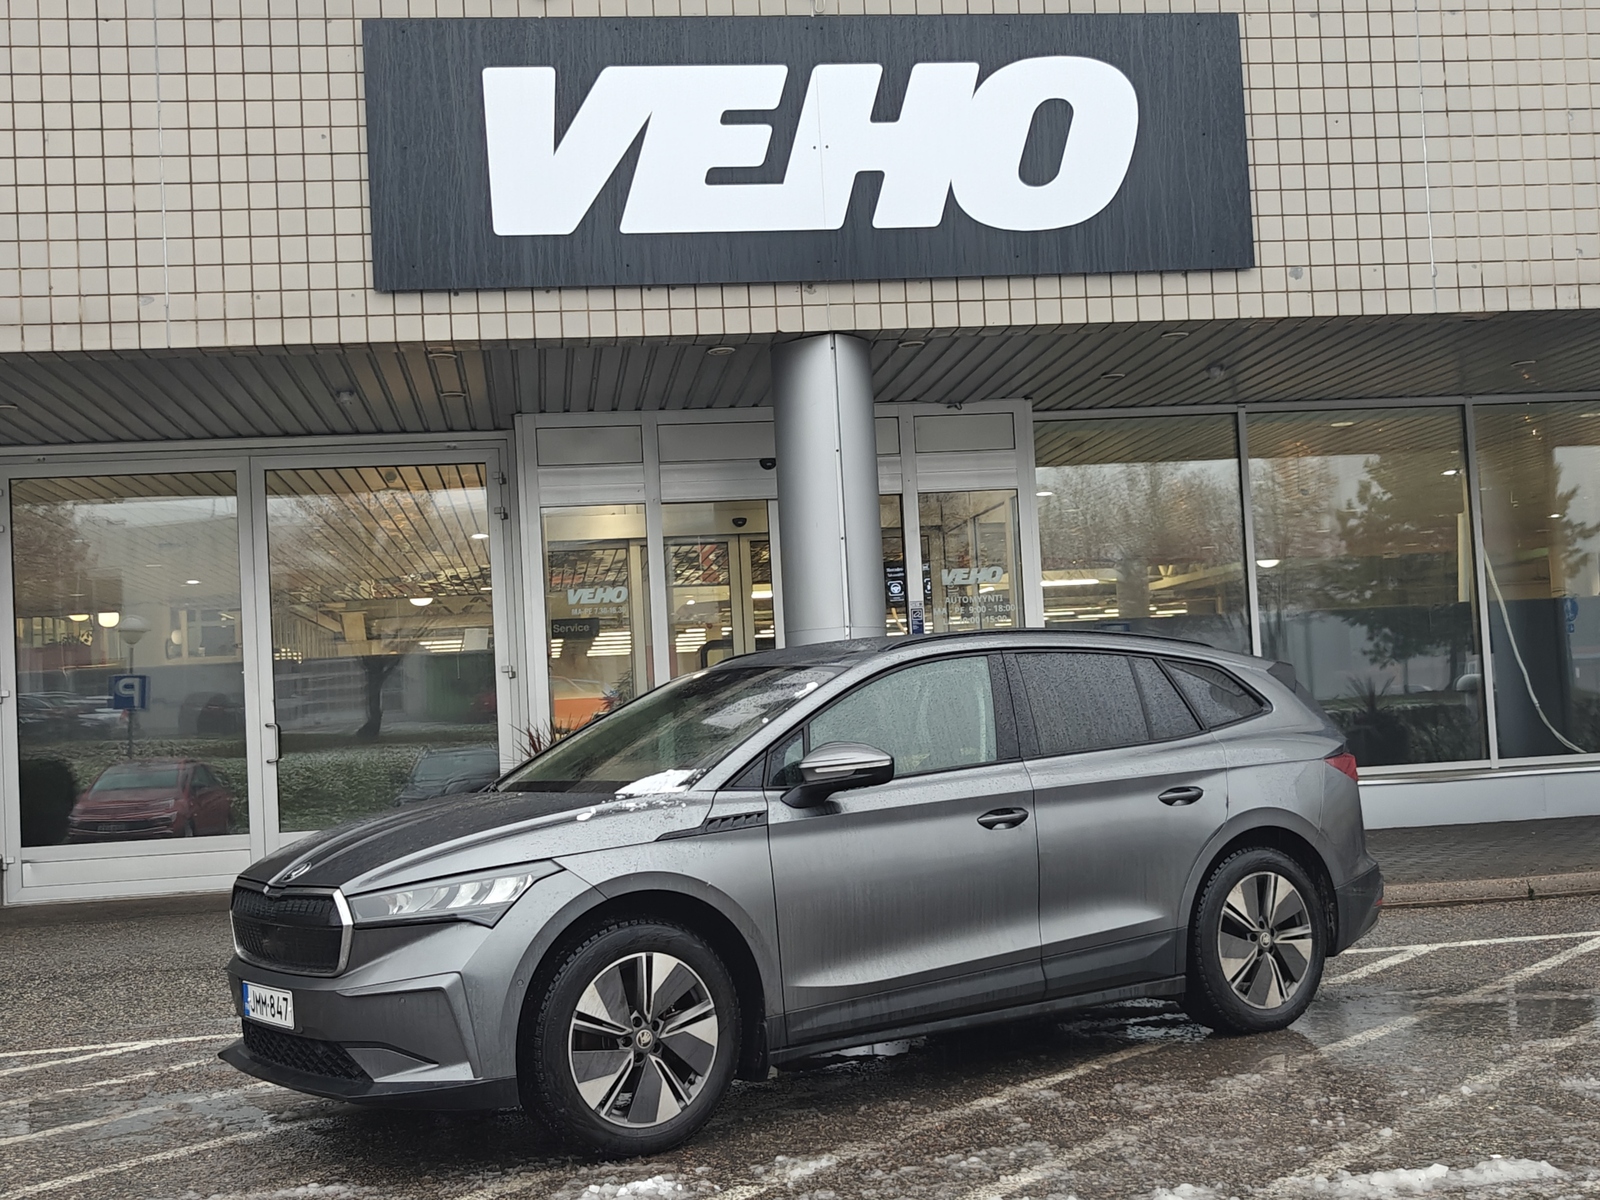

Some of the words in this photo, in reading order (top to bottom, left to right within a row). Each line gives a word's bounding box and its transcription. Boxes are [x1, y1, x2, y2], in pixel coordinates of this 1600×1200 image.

[482, 55, 1139, 235] VEHO
[941, 566, 1003, 586] VEHO
[567, 586, 628, 605] VEHO
[945, 594, 1003, 604] AUTOMYYNTI
[954, 606, 965, 614] PE
[968, 605, 987, 614] 9:00
[993, 604, 1015, 612] 18:00
[552, 623, 590, 633] Service
[250, 989, 289, 1022] JMM-847
